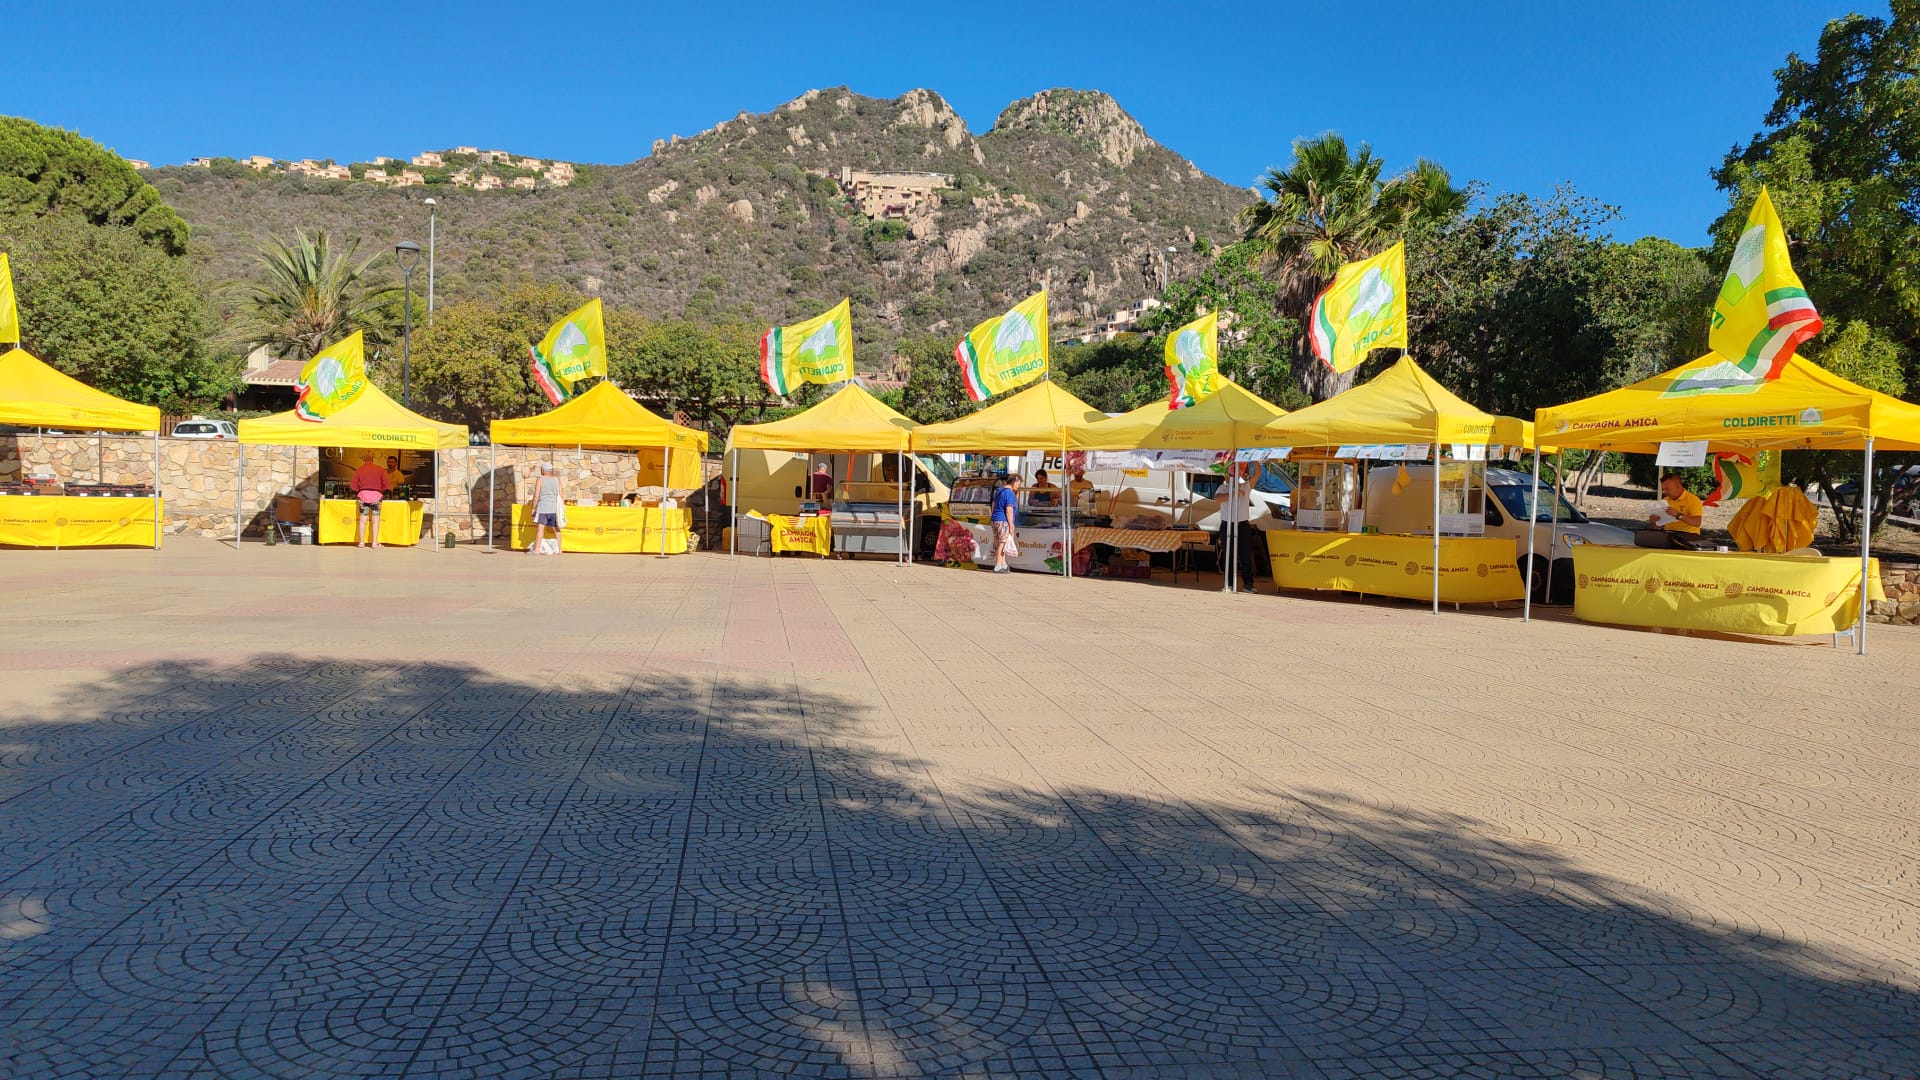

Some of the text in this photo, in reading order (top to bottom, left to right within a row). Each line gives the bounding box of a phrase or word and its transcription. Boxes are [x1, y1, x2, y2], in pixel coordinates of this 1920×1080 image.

[1572, 417, 1658, 430] CAMPAGNA AMICA
[1723, 414, 1796, 428] COLDIRETTI
[371, 433, 417, 442] COLDIRETTI
[789, 536, 813, 544] AMICA
[1421, 565, 1449, 573] CAMGNA
[1664, 580, 1694, 588] CAMPAGNA
[1746, 585, 1812, 599] CAMPAGNA AMICA
